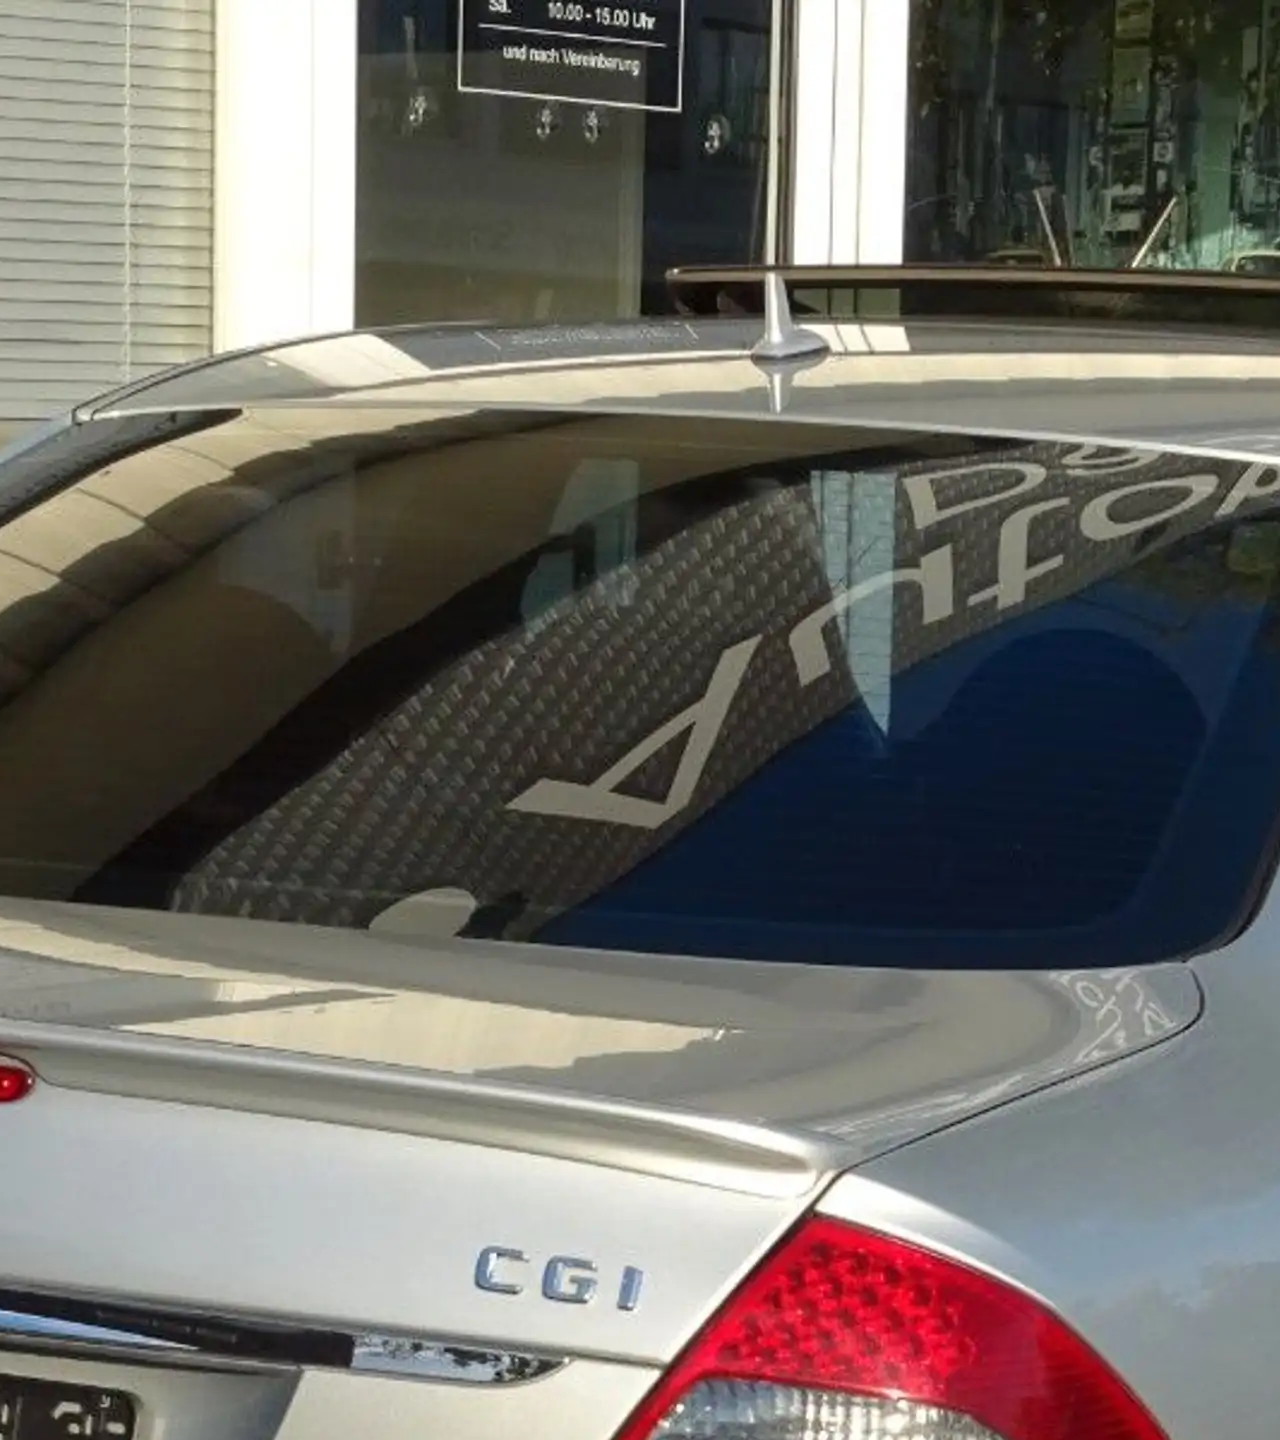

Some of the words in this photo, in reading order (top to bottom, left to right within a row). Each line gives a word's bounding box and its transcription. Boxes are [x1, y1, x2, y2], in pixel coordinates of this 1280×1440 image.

[548, 2, 584, 21] 10.00
[595, 7, 629, 27] 15.00
[632, 12, 656, 30] Uhr
[502, 45, 526, 61] und
[529, 48, 560, 64] nach
[563, 49, 641, 76] Vereinbarung
[474, 1245, 645, 1312] CGI
